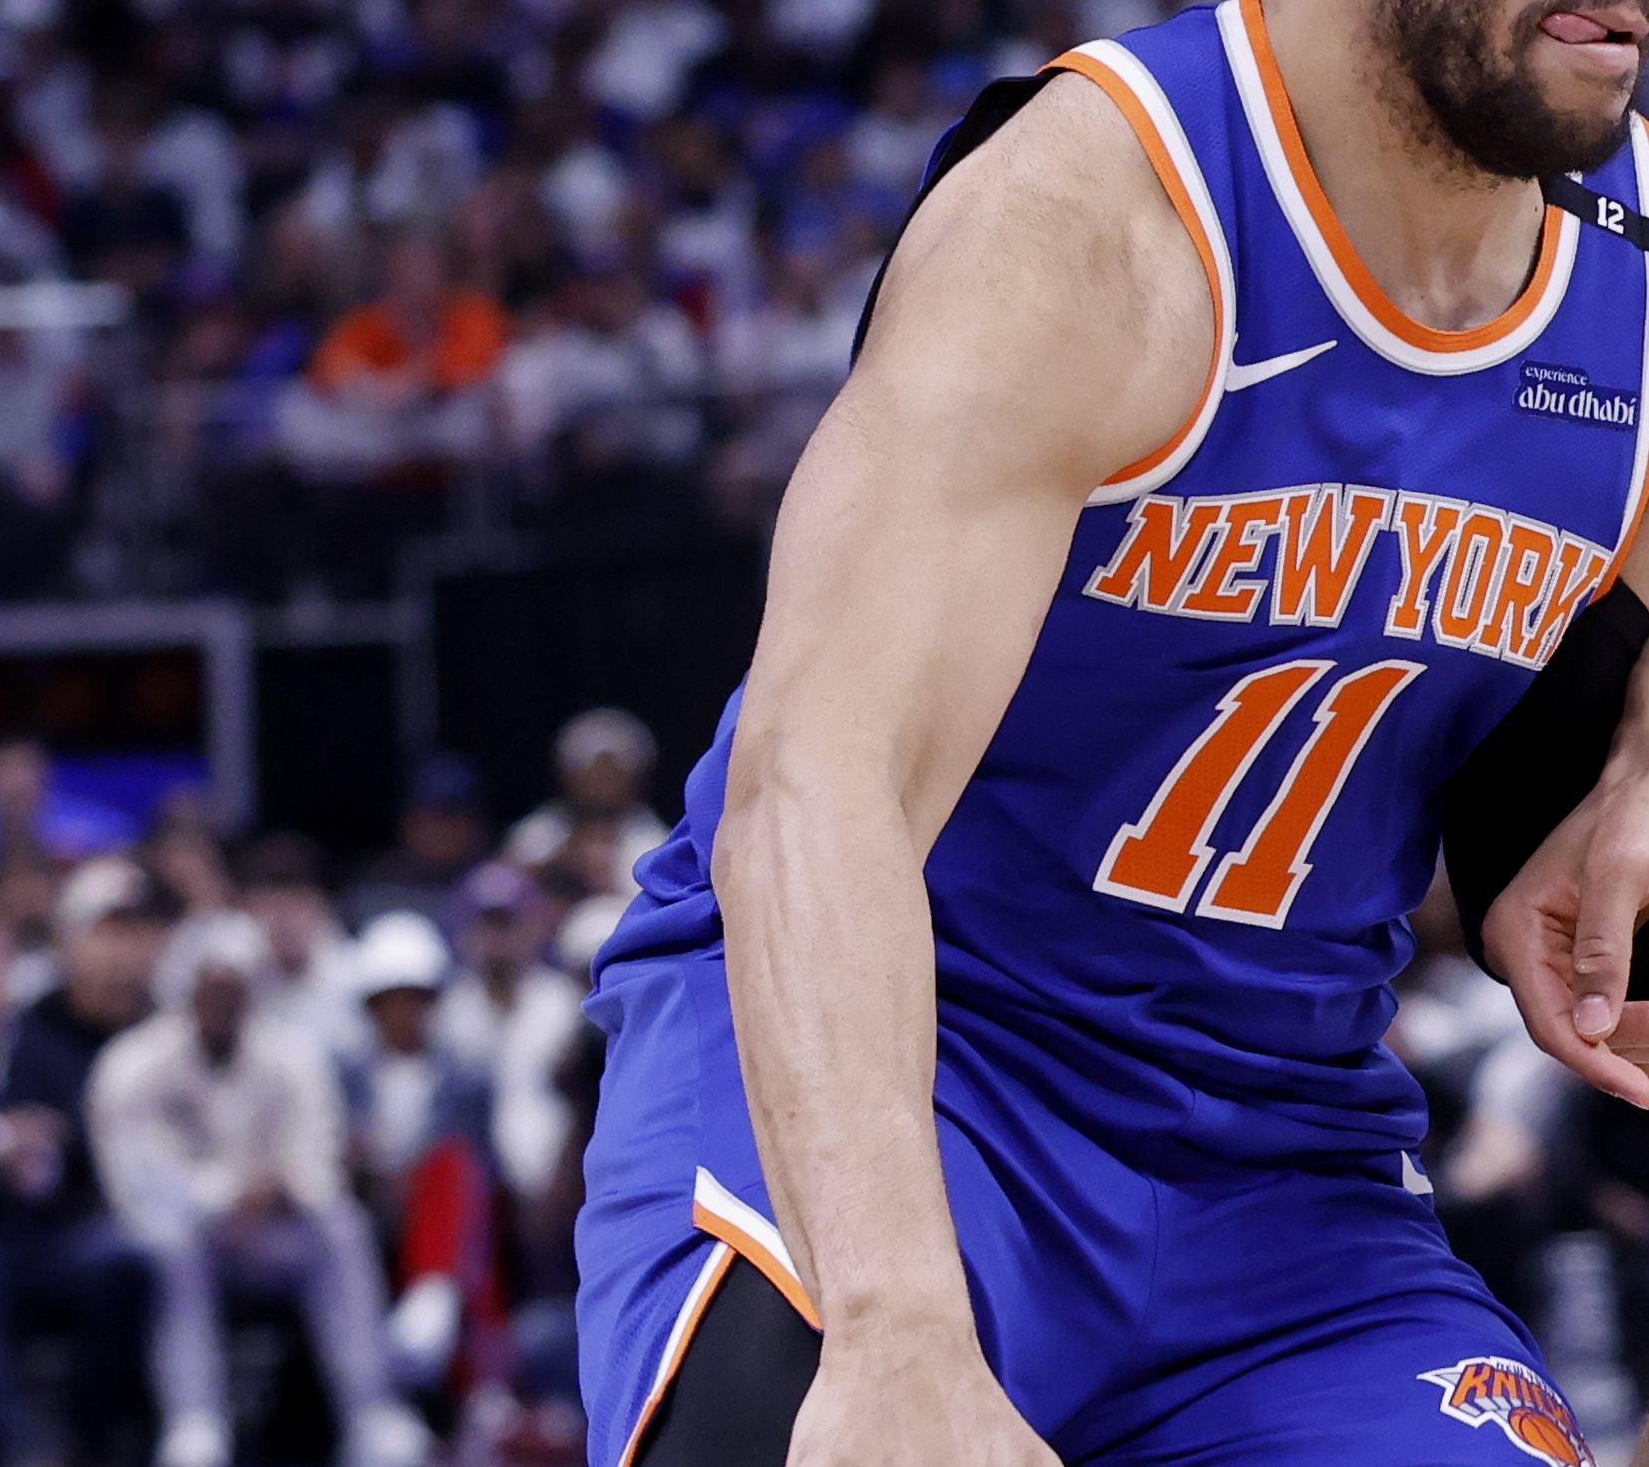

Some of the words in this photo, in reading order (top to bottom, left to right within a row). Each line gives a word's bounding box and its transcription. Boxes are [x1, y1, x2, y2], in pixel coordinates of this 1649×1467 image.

[1597, 196, 1625, 235] 12
[1525, 366, 1589, 386] experience
[1518, 383, 1566, 414] abu
[1568, 389, 1638, 426] dhabi
[1082, 483, 1397, 628] NEW
[1383, 489, 1614, 672] YORK
[1093, 659, 1427, 930] 11
